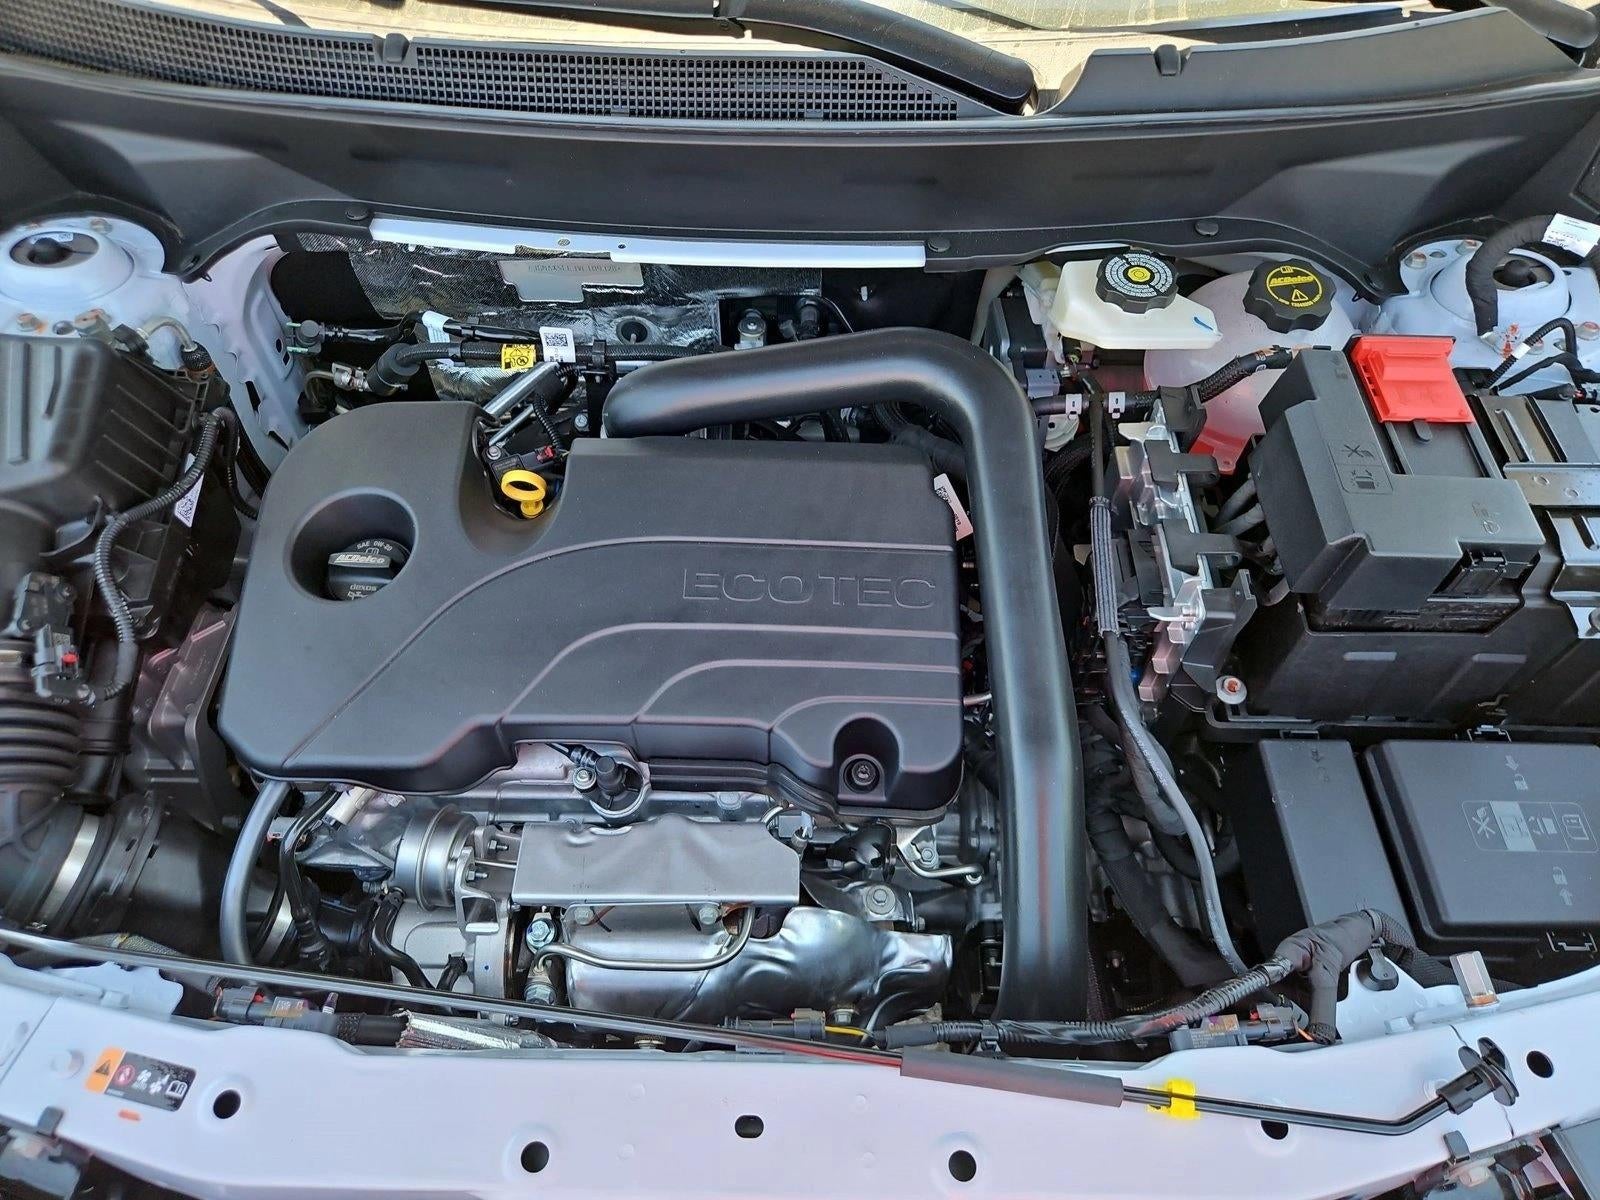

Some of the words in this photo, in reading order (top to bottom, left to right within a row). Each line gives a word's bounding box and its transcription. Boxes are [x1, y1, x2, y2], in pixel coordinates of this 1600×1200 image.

[1269, 275, 1314, 286] ACDelco
[357, 541, 370, 550] SAE
[374, 541, 393, 551] 0W-20
[334, 554, 385, 564] ACDelco
[350, 584, 377, 592] dexos
[682, 568, 937, 610] ECOTEC
